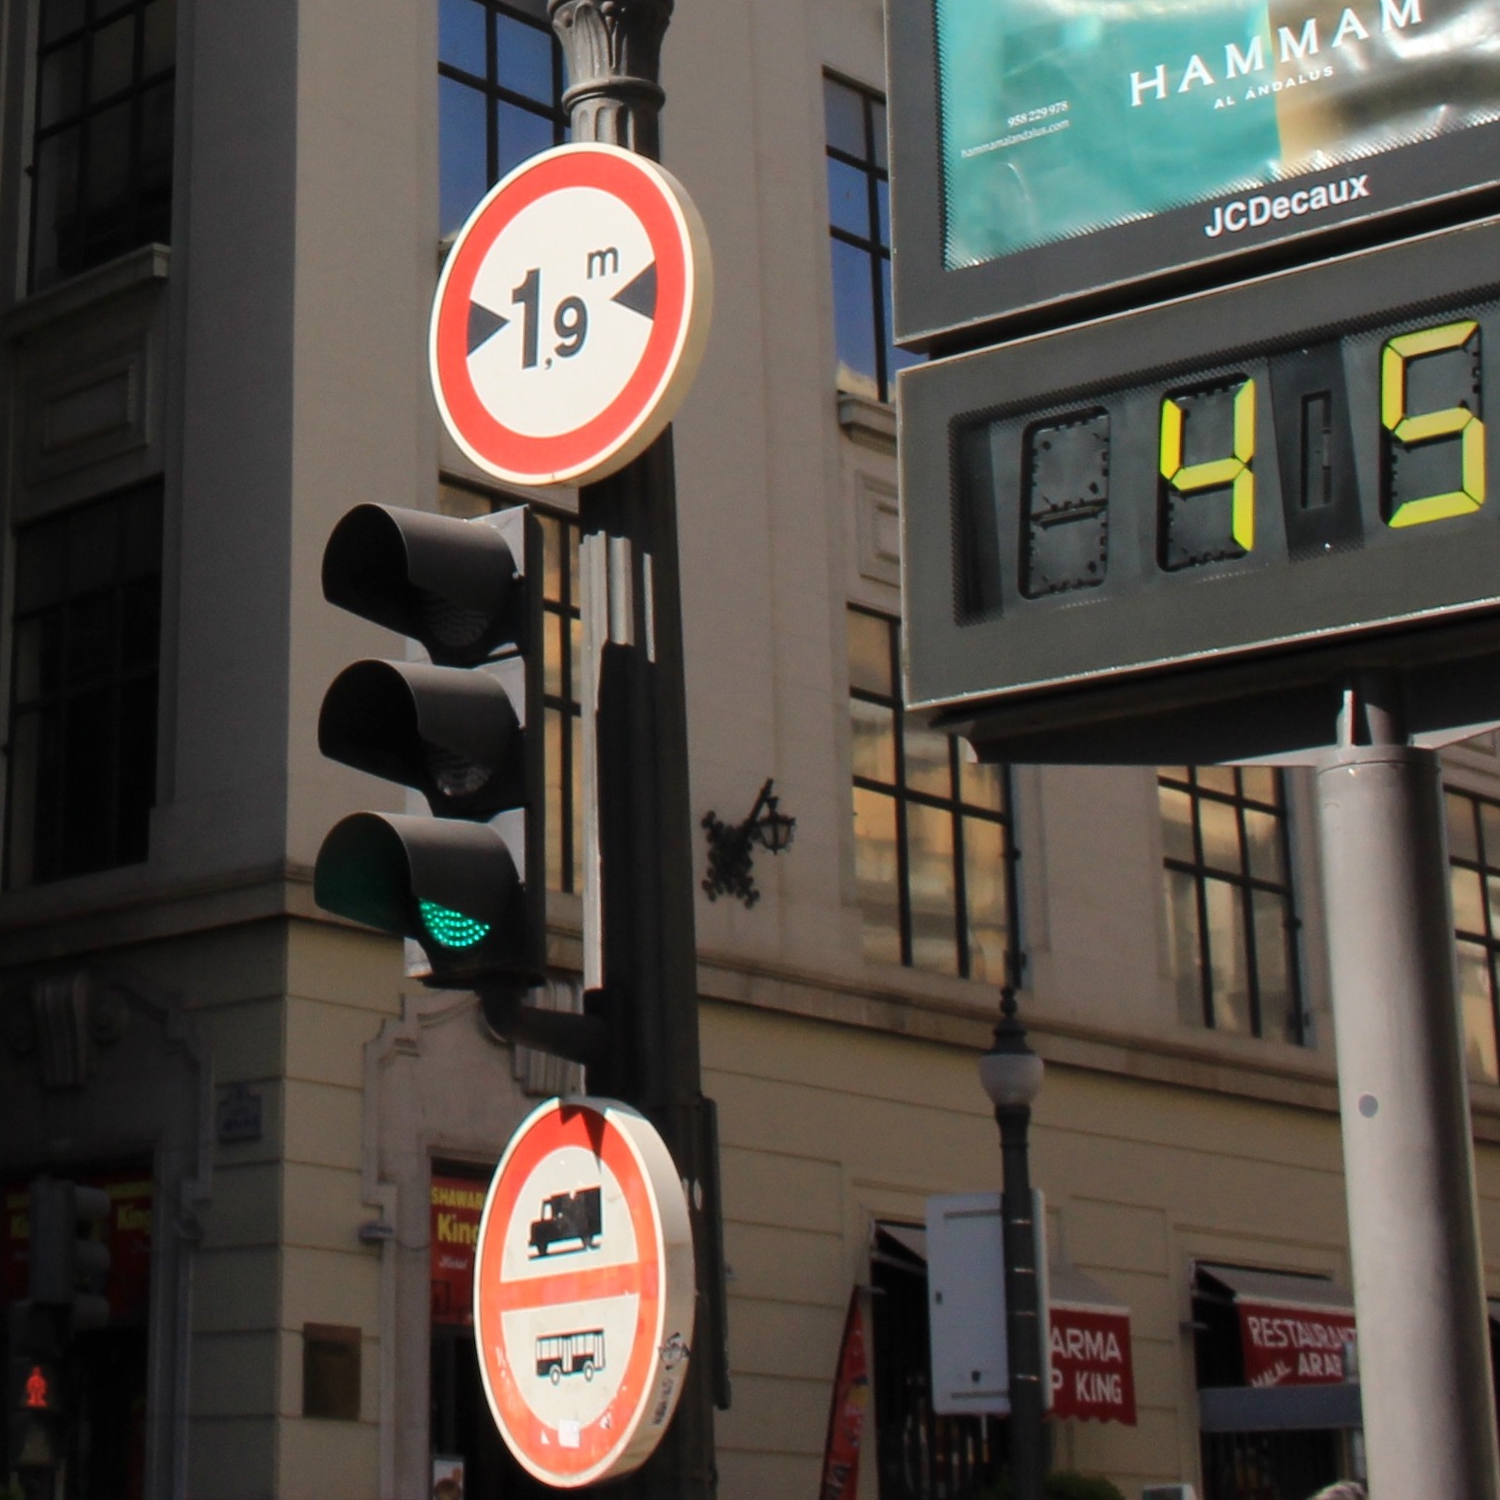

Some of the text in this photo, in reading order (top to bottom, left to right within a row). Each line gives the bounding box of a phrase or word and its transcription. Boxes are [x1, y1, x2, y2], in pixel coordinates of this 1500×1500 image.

[1007, 113, 1028, 128] 958
[1028, 107, 1048, 123] 229
[1214, 96, 1235, 109] AL
[961, 119, 1070, 158] hammamalandalus.com
[1204, 174, 1370, 237] JCDecaux
[431, 1186, 485, 1211] SHAWAR
[1051, 1326, 1122, 1362] ARMA
[1075, 1370, 1123, 1404] KING
